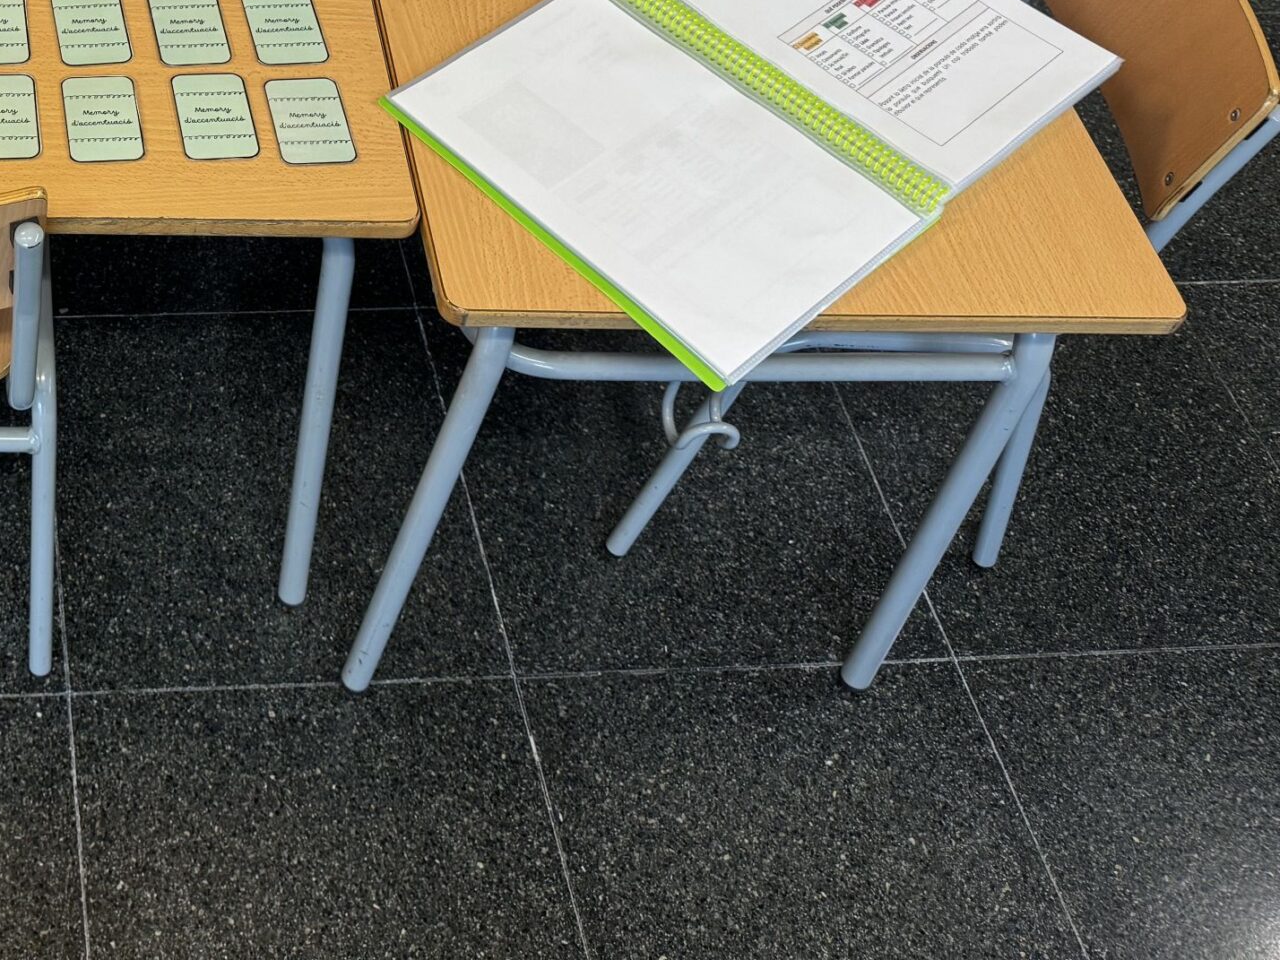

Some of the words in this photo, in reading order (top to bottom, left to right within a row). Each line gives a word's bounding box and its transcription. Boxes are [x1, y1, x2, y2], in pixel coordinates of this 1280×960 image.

[169, 18, 204, 26] Memory
[264, 17, 300, 25] Memory
[82, 109, 119, 117] Memory
[194, 106, 231, 114] Memory
[288, 112, 326, 120] Memory
